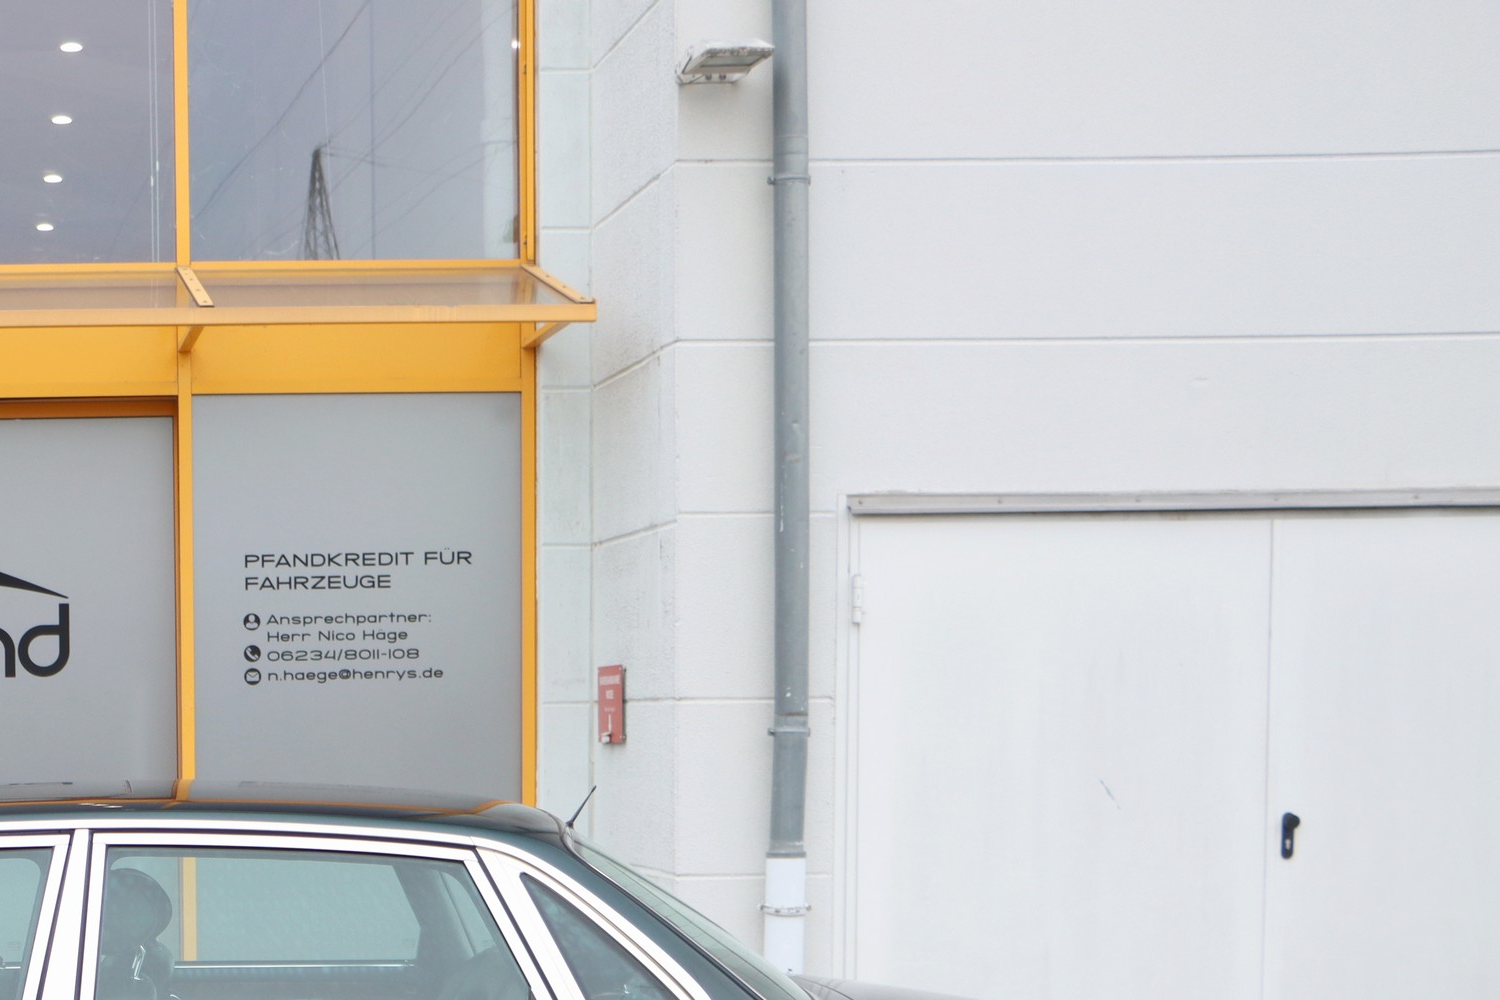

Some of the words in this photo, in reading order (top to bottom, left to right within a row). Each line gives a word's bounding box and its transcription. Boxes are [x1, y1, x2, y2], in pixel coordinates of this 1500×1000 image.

[244, 552, 415, 568] PFANDKREDIT
[424, 547, 473, 565] FÜR
[245, 575, 391, 590] FAHRZEUGE
[266, 612, 432, 627] Ansprechpartner:
[267, 631, 311, 643] Herr
[318, 630, 355, 641] Nico
[362, 629, 408, 643] Häge
[267, 648, 420, 662] 06234/8011-108
[267, 667, 444, 684] n.haege@henrys.de
